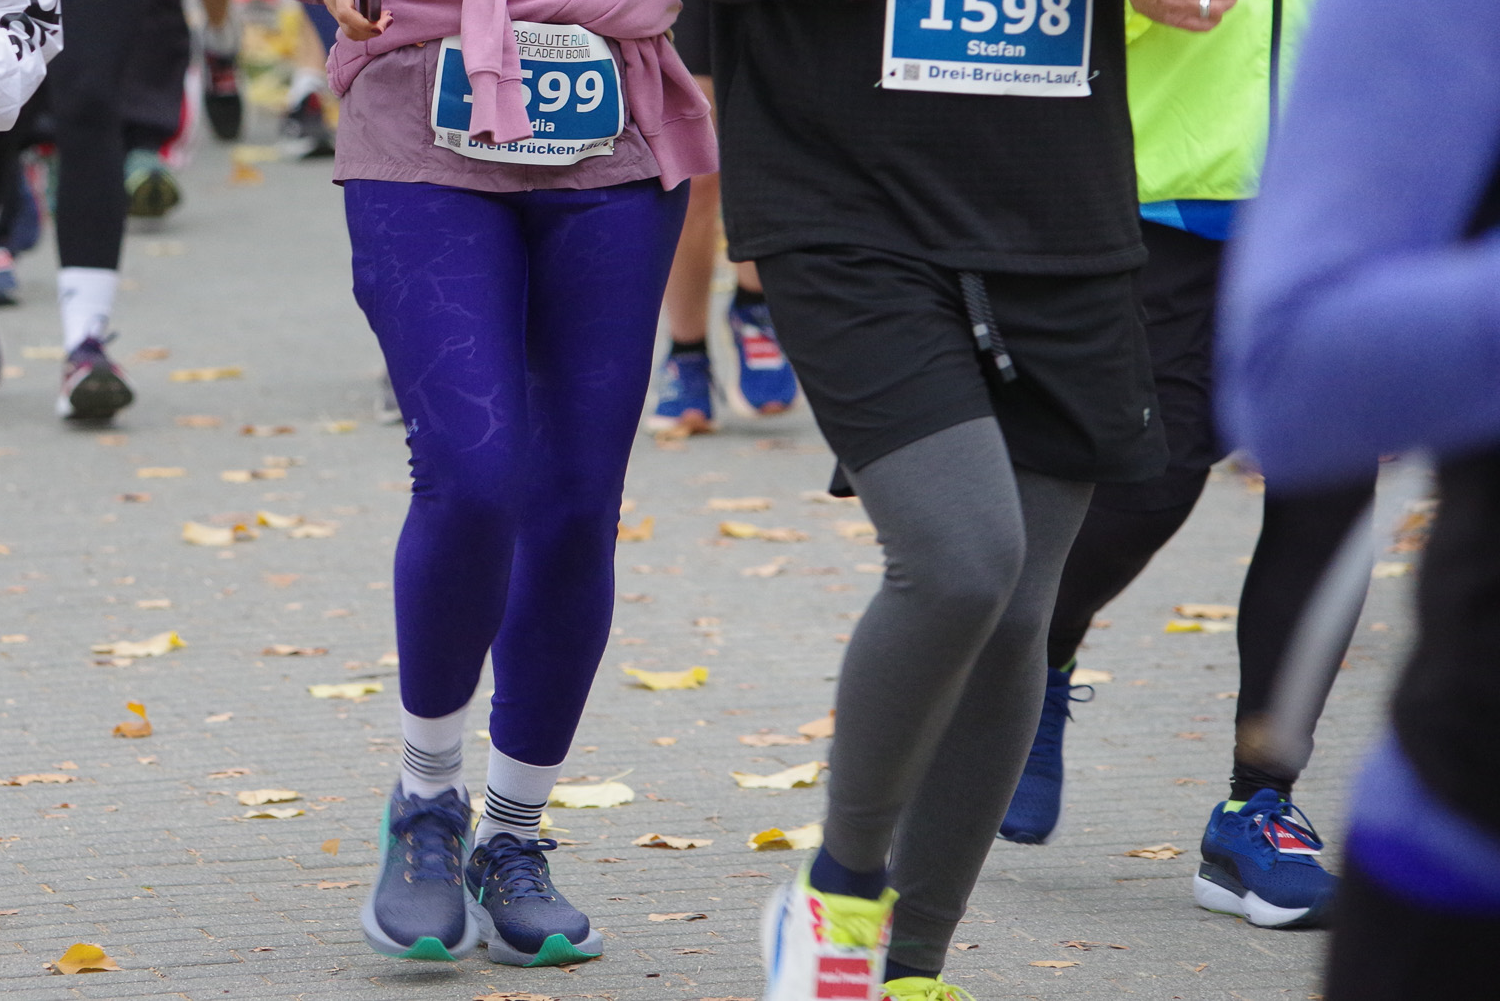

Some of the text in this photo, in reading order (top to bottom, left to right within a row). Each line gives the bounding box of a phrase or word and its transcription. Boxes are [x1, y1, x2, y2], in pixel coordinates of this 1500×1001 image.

[566, 48, 591, 59] BONN
[966, 40, 1026, 57] Stefan
[928, 65, 1078, 85] Drei-Brücken-Lauf
[531, 118, 556, 132] dia
